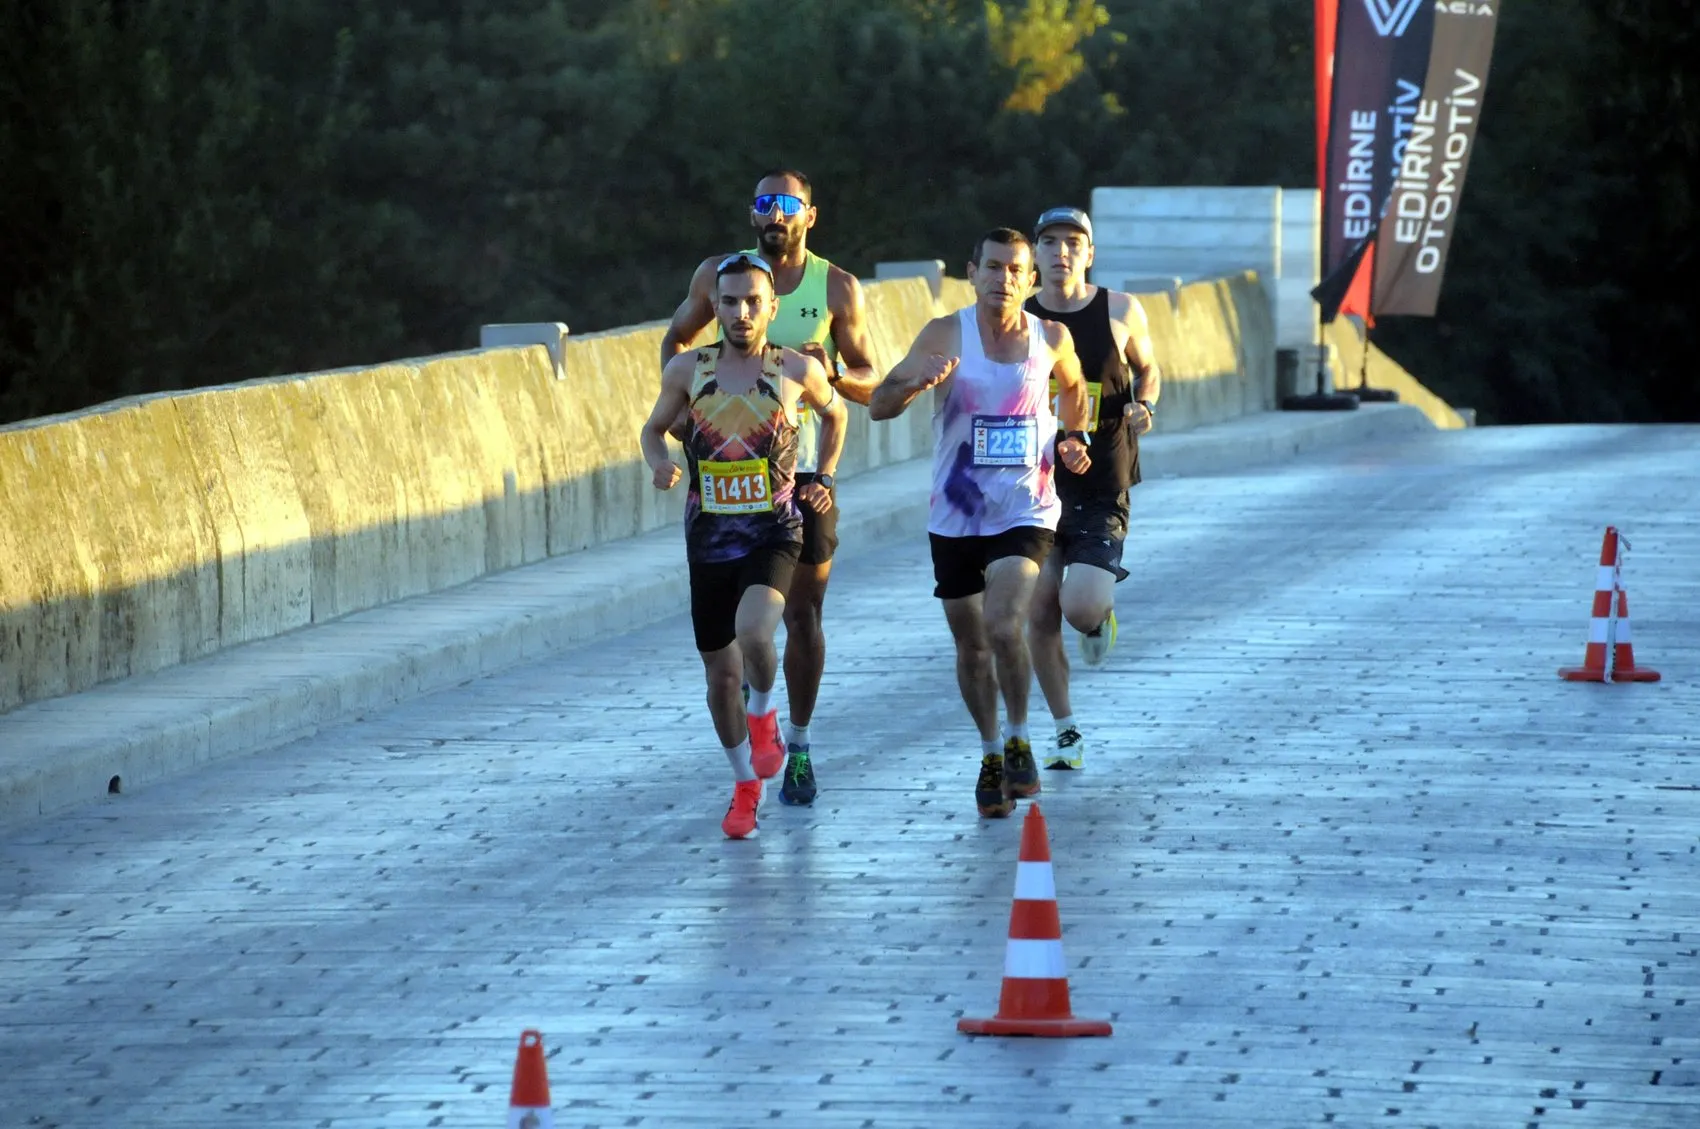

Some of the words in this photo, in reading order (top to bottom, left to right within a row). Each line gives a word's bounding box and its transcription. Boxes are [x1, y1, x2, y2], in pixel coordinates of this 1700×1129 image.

[1435, 1, 1494, 16] ACIA
[1339, 110, 1377, 239] EDİRNE
[1394, 100, 1438, 243] EDİRNE
[1415, 68, 1481, 273] OTOMOTİV
[704, 475, 711, 483] K
[705, 486, 712, 496] 10
[717, 474, 766, 500] 1413
